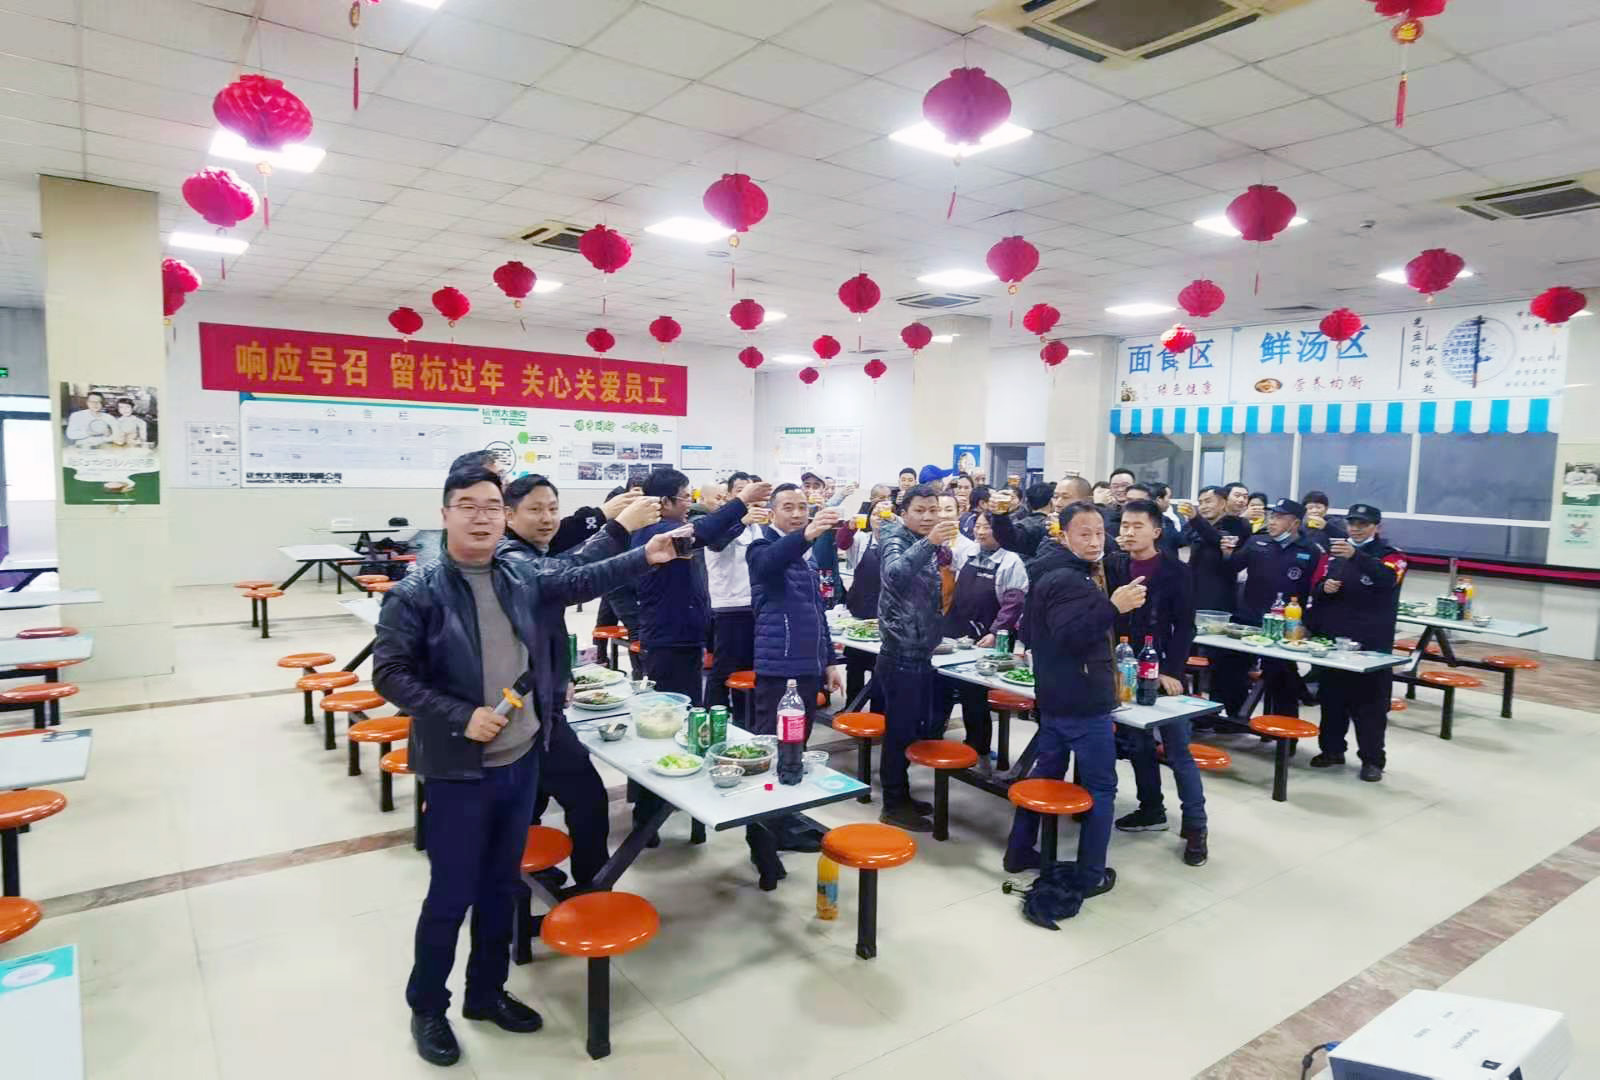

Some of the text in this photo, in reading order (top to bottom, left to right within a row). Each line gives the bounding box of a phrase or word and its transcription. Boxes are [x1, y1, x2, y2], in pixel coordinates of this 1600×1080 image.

[1128, 338, 1214, 374] 面食区
[1260, 324, 1370, 364] 鲜汤区
[235, 340, 667, 404] 响应号召 留杭过年 关心关爱员工
